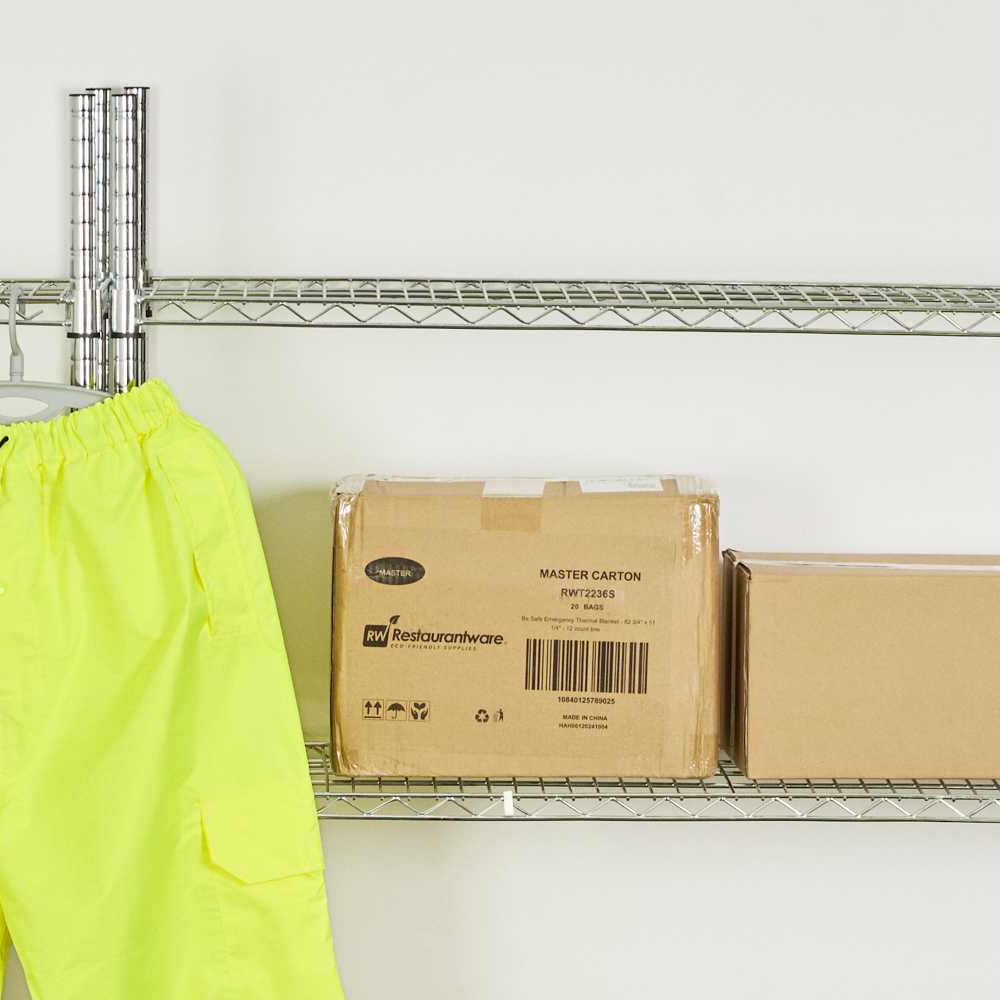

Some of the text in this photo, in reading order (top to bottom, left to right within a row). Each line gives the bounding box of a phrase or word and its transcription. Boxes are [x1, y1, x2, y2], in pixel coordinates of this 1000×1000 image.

[540, 569, 641, 581] MASTER CARTON
[561, 588, 615, 598] RWT2236S
[366, 630, 386, 642] RW
[392, 629, 504, 645] Restaurantware
